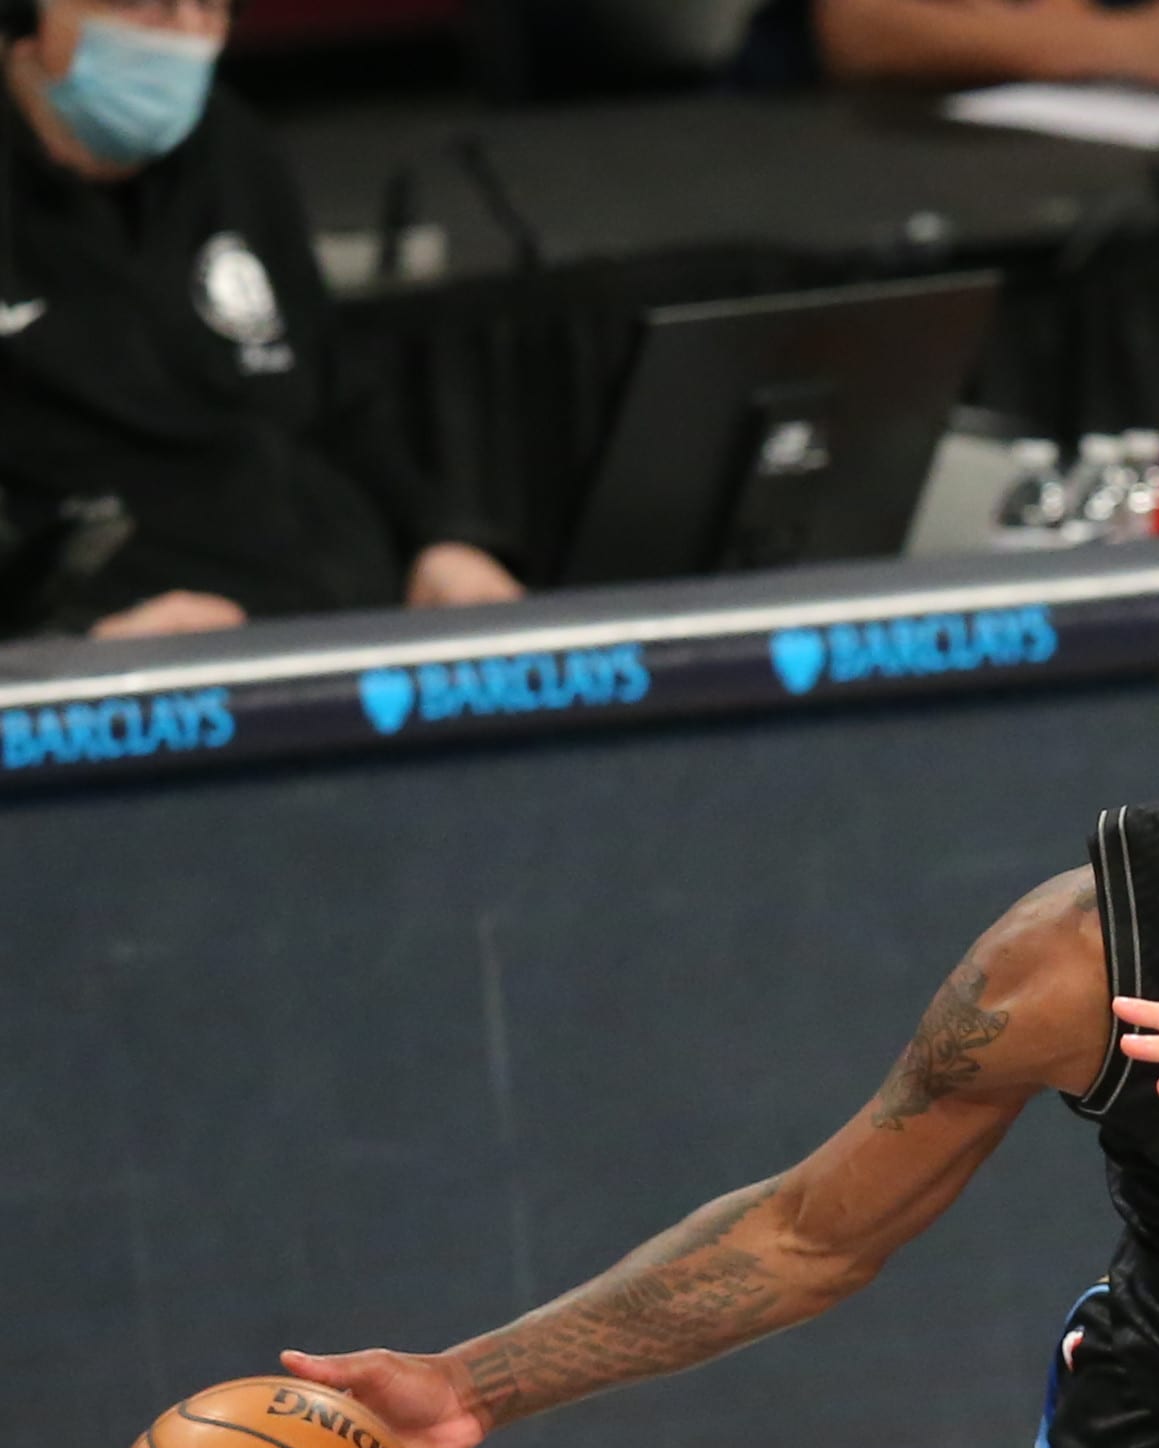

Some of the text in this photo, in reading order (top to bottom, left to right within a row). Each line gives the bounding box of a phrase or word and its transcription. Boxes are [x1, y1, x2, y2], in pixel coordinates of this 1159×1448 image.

[417, 642, 652, 721] BARCLAYS
[827, 603, 1058, 683] BARCLAYS
[1, 687, 236, 769] BARCLAYS
